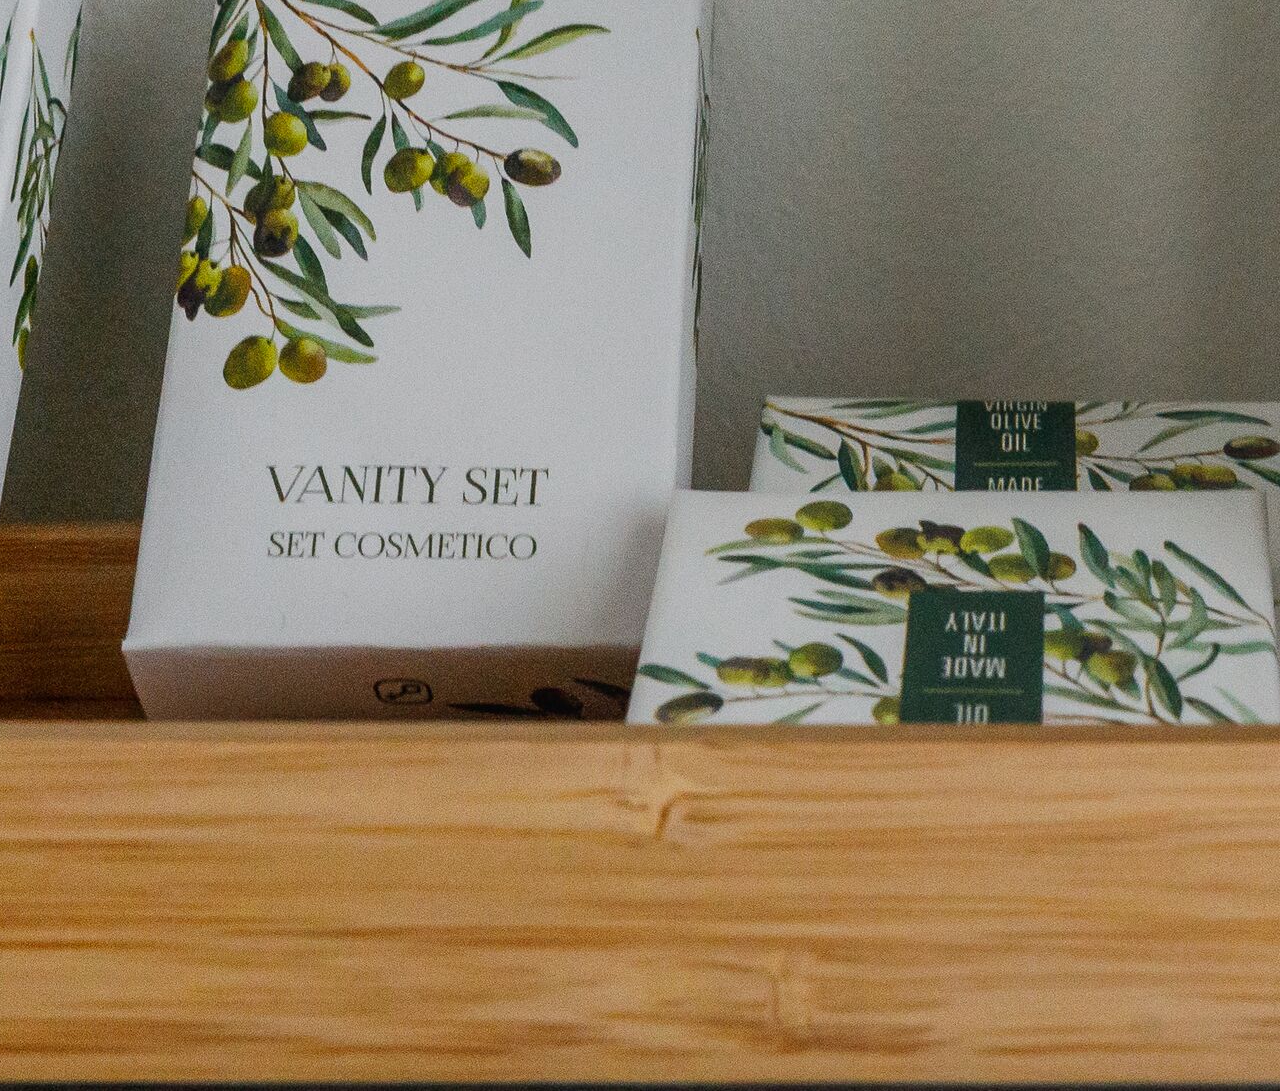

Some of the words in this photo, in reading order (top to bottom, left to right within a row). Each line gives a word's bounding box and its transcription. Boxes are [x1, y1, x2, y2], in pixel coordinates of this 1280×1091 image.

[990, 412, 1041, 430] OLIVE
[1001, 432, 1030, 453] OIL
[266, 465, 450, 505] VANITY
[461, 466, 550, 508] SET
[266, 531, 325, 558] SET
[333, 532, 538, 561] COSMETICO
[944, 611, 1006, 632] ITALY
[964, 634, 987, 655] IN
[943, 656, 1007, 680] MADE
